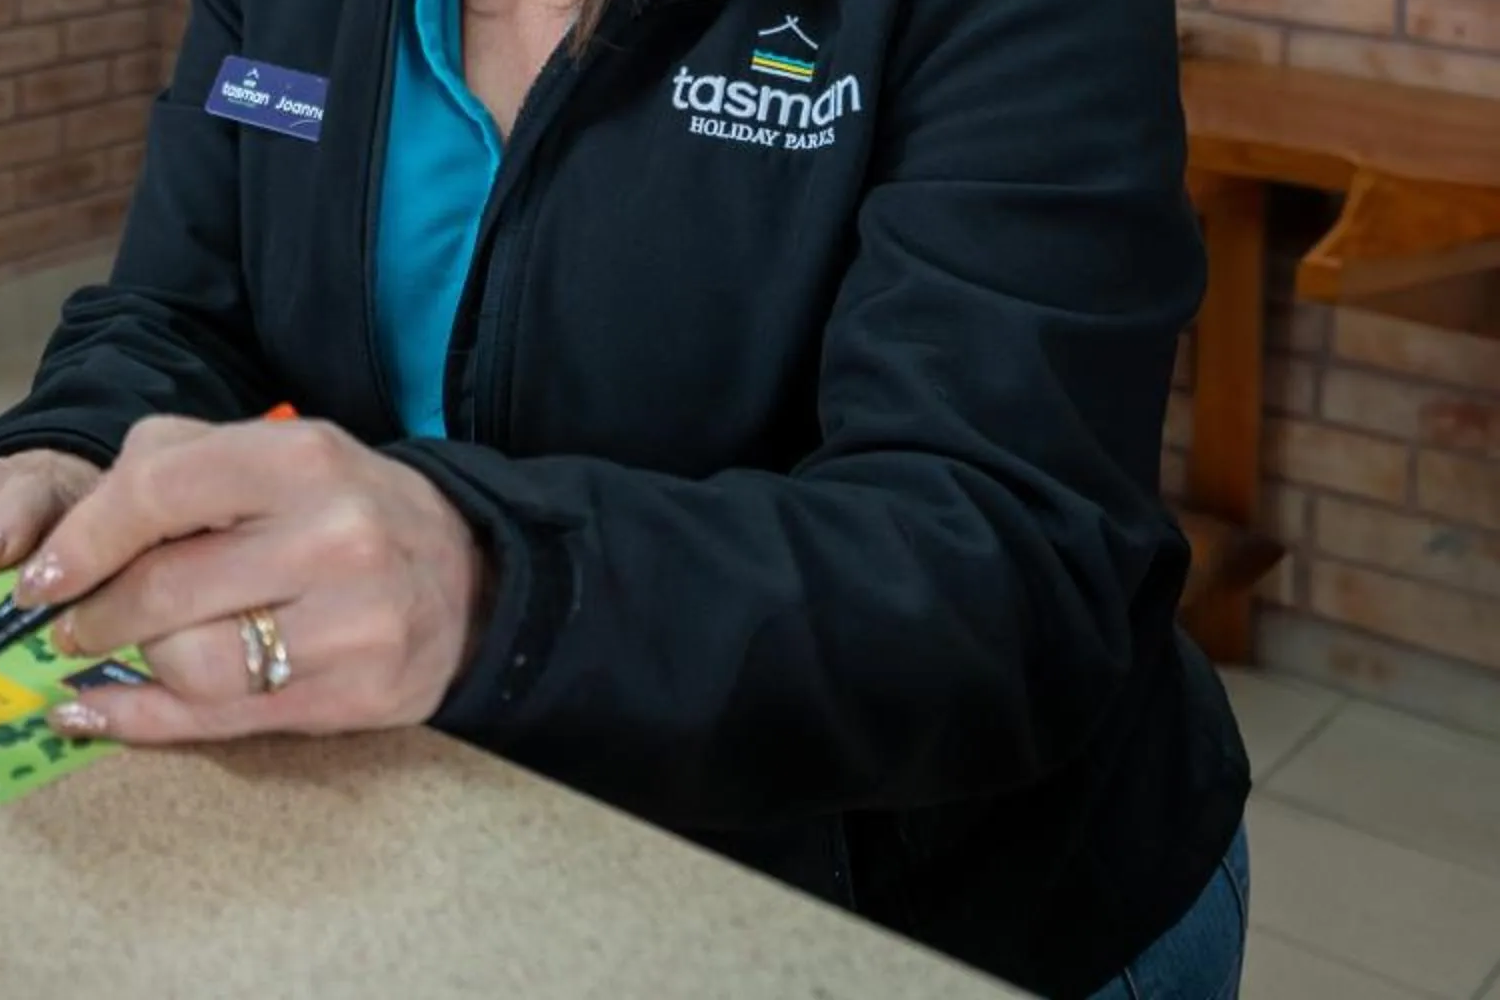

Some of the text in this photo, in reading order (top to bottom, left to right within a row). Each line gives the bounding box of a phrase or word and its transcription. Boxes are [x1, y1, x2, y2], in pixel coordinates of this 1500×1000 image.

[221, 81, 270, 105] tasman
[672, 66, 862, 129] tasman
[689, 115, 836, 151] HOLIDAY PARKS
